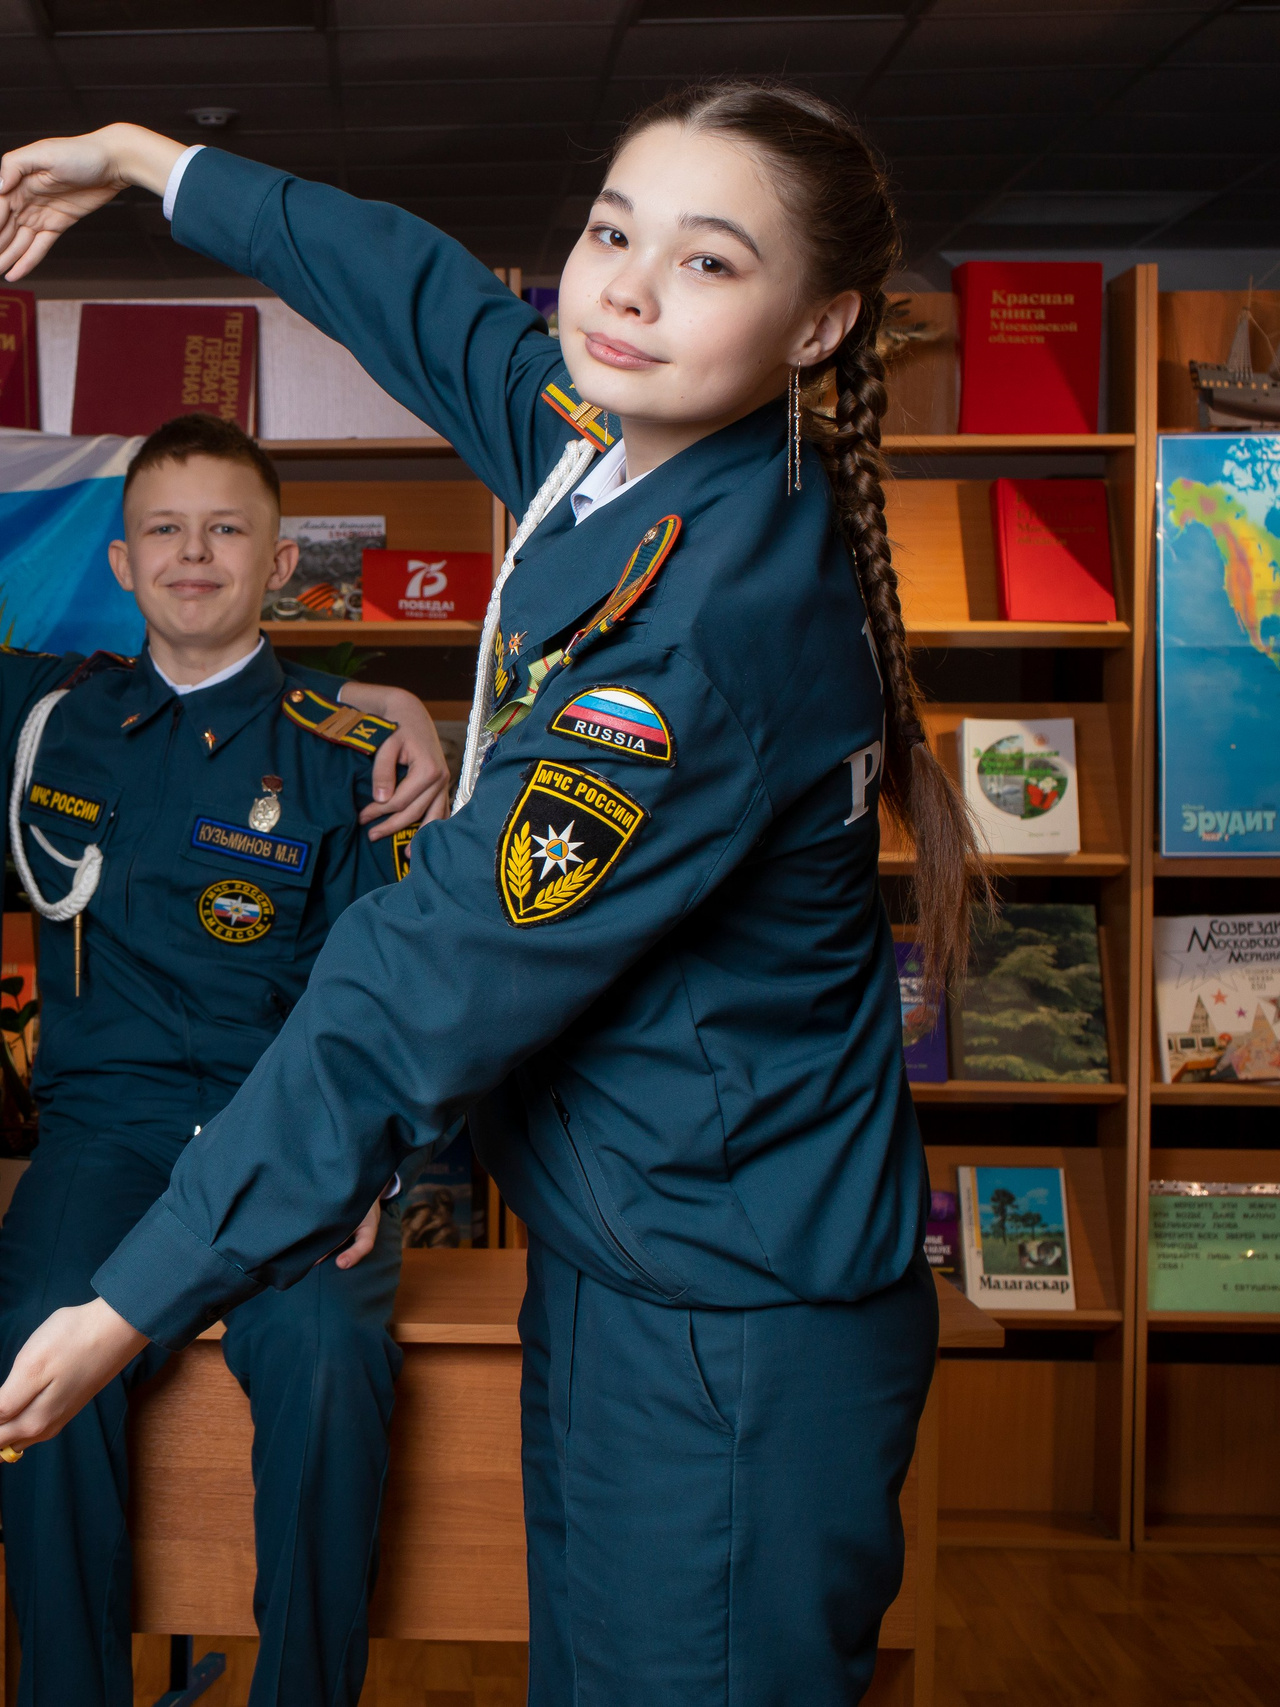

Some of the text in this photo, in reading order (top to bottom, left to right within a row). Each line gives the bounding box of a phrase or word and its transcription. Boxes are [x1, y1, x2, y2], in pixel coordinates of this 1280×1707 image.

[989, 308, 1046, 320] книга
[991, 289, 1075, 309] Красная
[987, 332, 1046, 345] области
[989, 321, 1078, 333] Московской
[182, 334, 204, 405] КОННАЯ
[201, 337, 223, 404] ПЕРВАЯ
[405, 558, 448, 599] 75
[398, 599, 455, 612] ПОБЕДА!
[352, 722, 378, 740] К
[574, 719, 646, 753] RUSSIA
[29, 784, 100, 822] МЧС РОССИИ
[536, 768, 636, 830] МЧС РОССИИ
[198, 823, 300, 865] КУЗЬМИНОВ М.Н.
[206, 883, 271, 915] МЧС РОССИИ
[979, 1275, 1070, 1294] Мадагаскар
